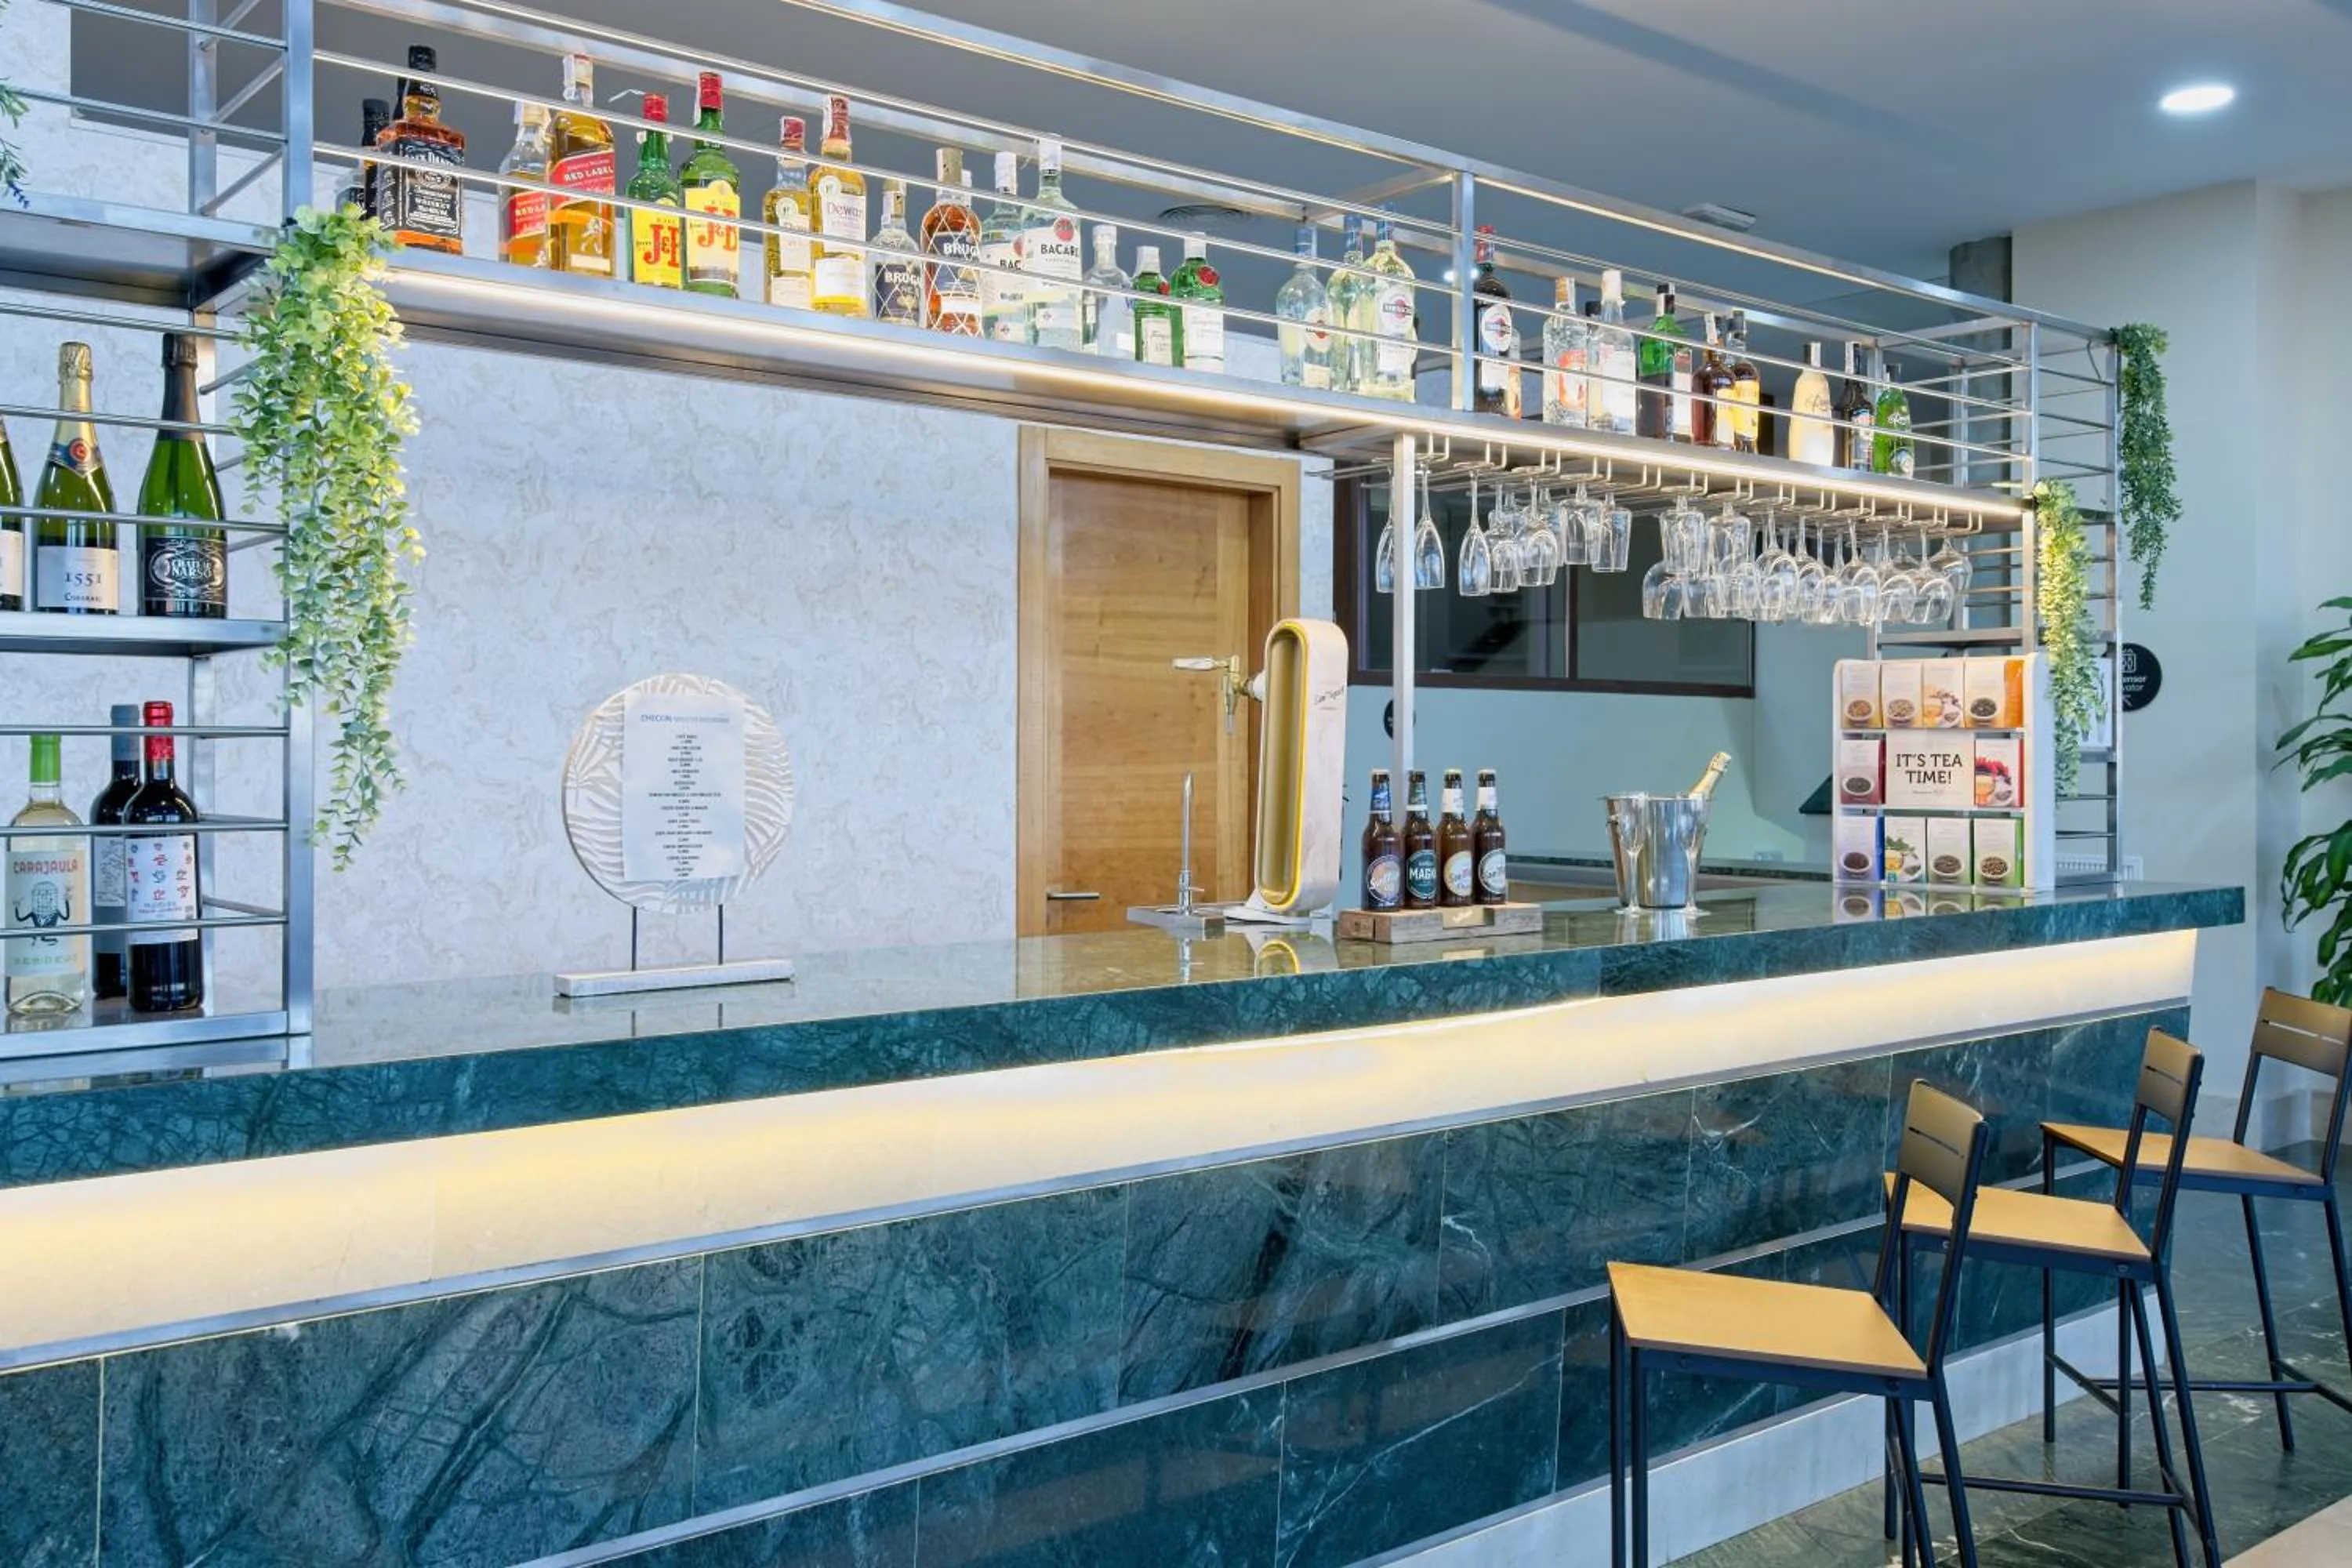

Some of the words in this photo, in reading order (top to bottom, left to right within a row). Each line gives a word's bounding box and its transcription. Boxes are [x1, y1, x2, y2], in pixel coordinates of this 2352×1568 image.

[64, 572, 102, 588] 1551
[1896, 753, 1926, 768] IT'S
[1930, 753, 1963, 768] TEA
[1905, 770, 1952, 785] TIME!
